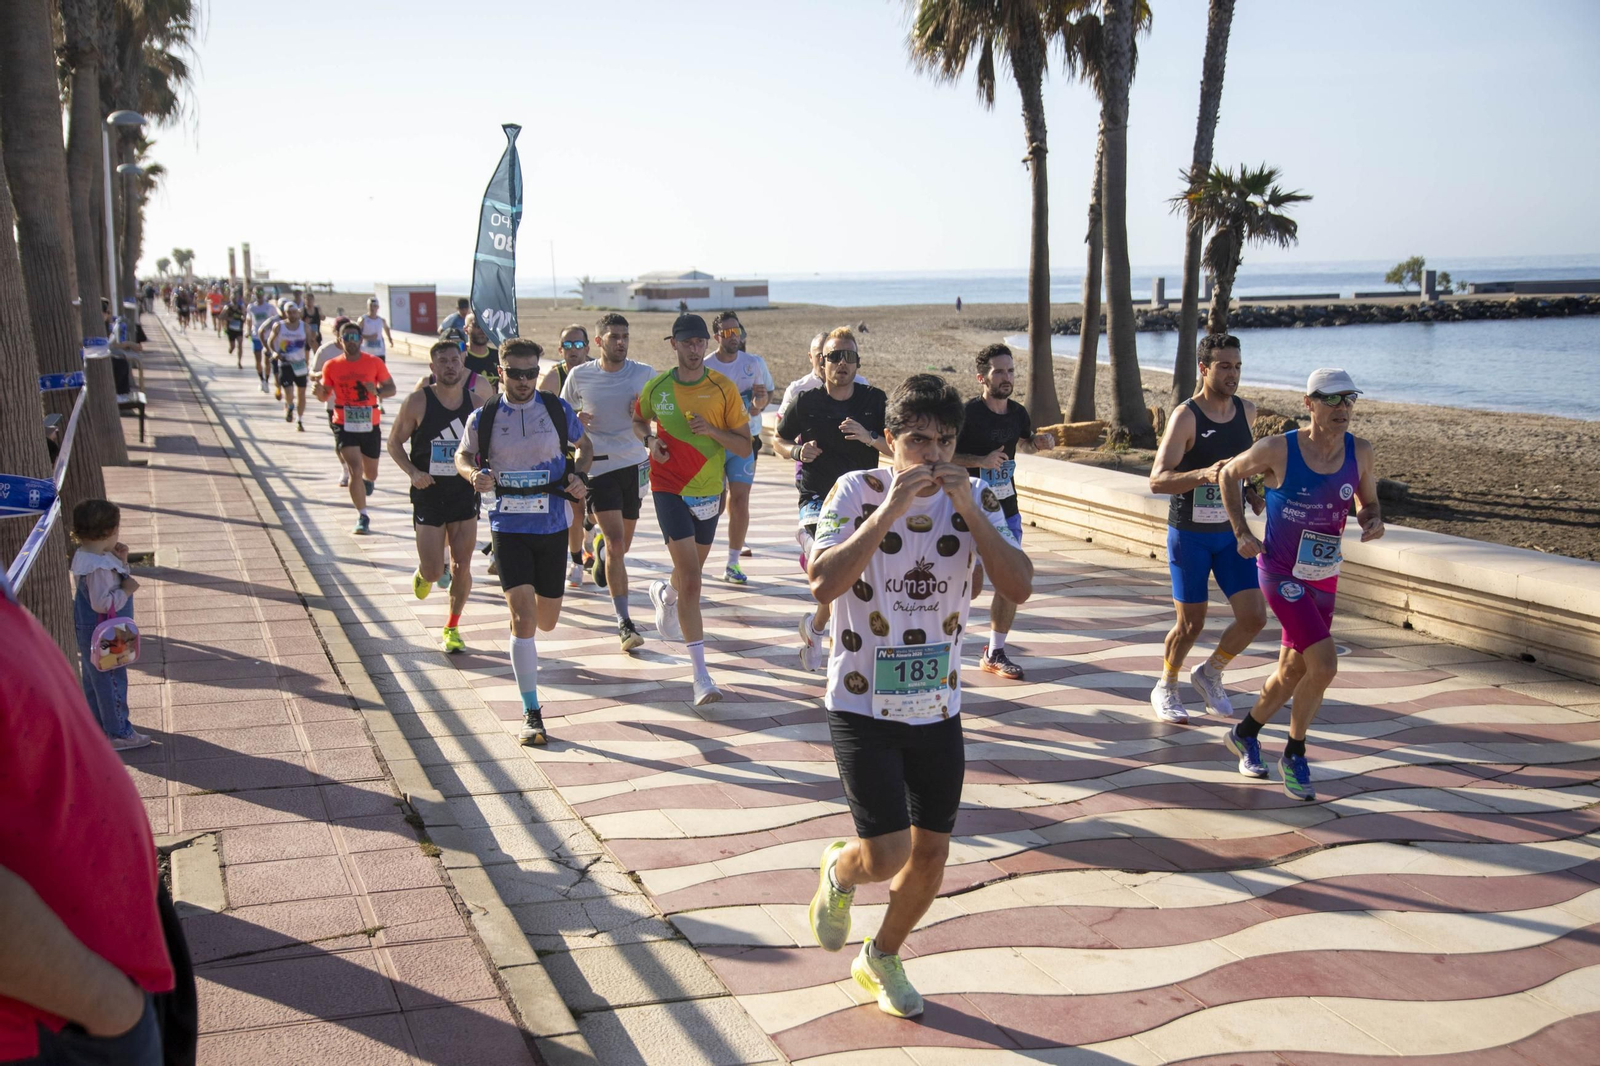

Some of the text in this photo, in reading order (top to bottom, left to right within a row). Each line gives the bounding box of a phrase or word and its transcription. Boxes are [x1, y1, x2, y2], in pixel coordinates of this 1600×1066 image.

[348, 411, 370, 420] 2144
[986, 468, 1012, 480] 136
[1312, 543, 1336, 559] 62
[893, 600, 939, 616] Original
[894, 658, 939, 682] 183
